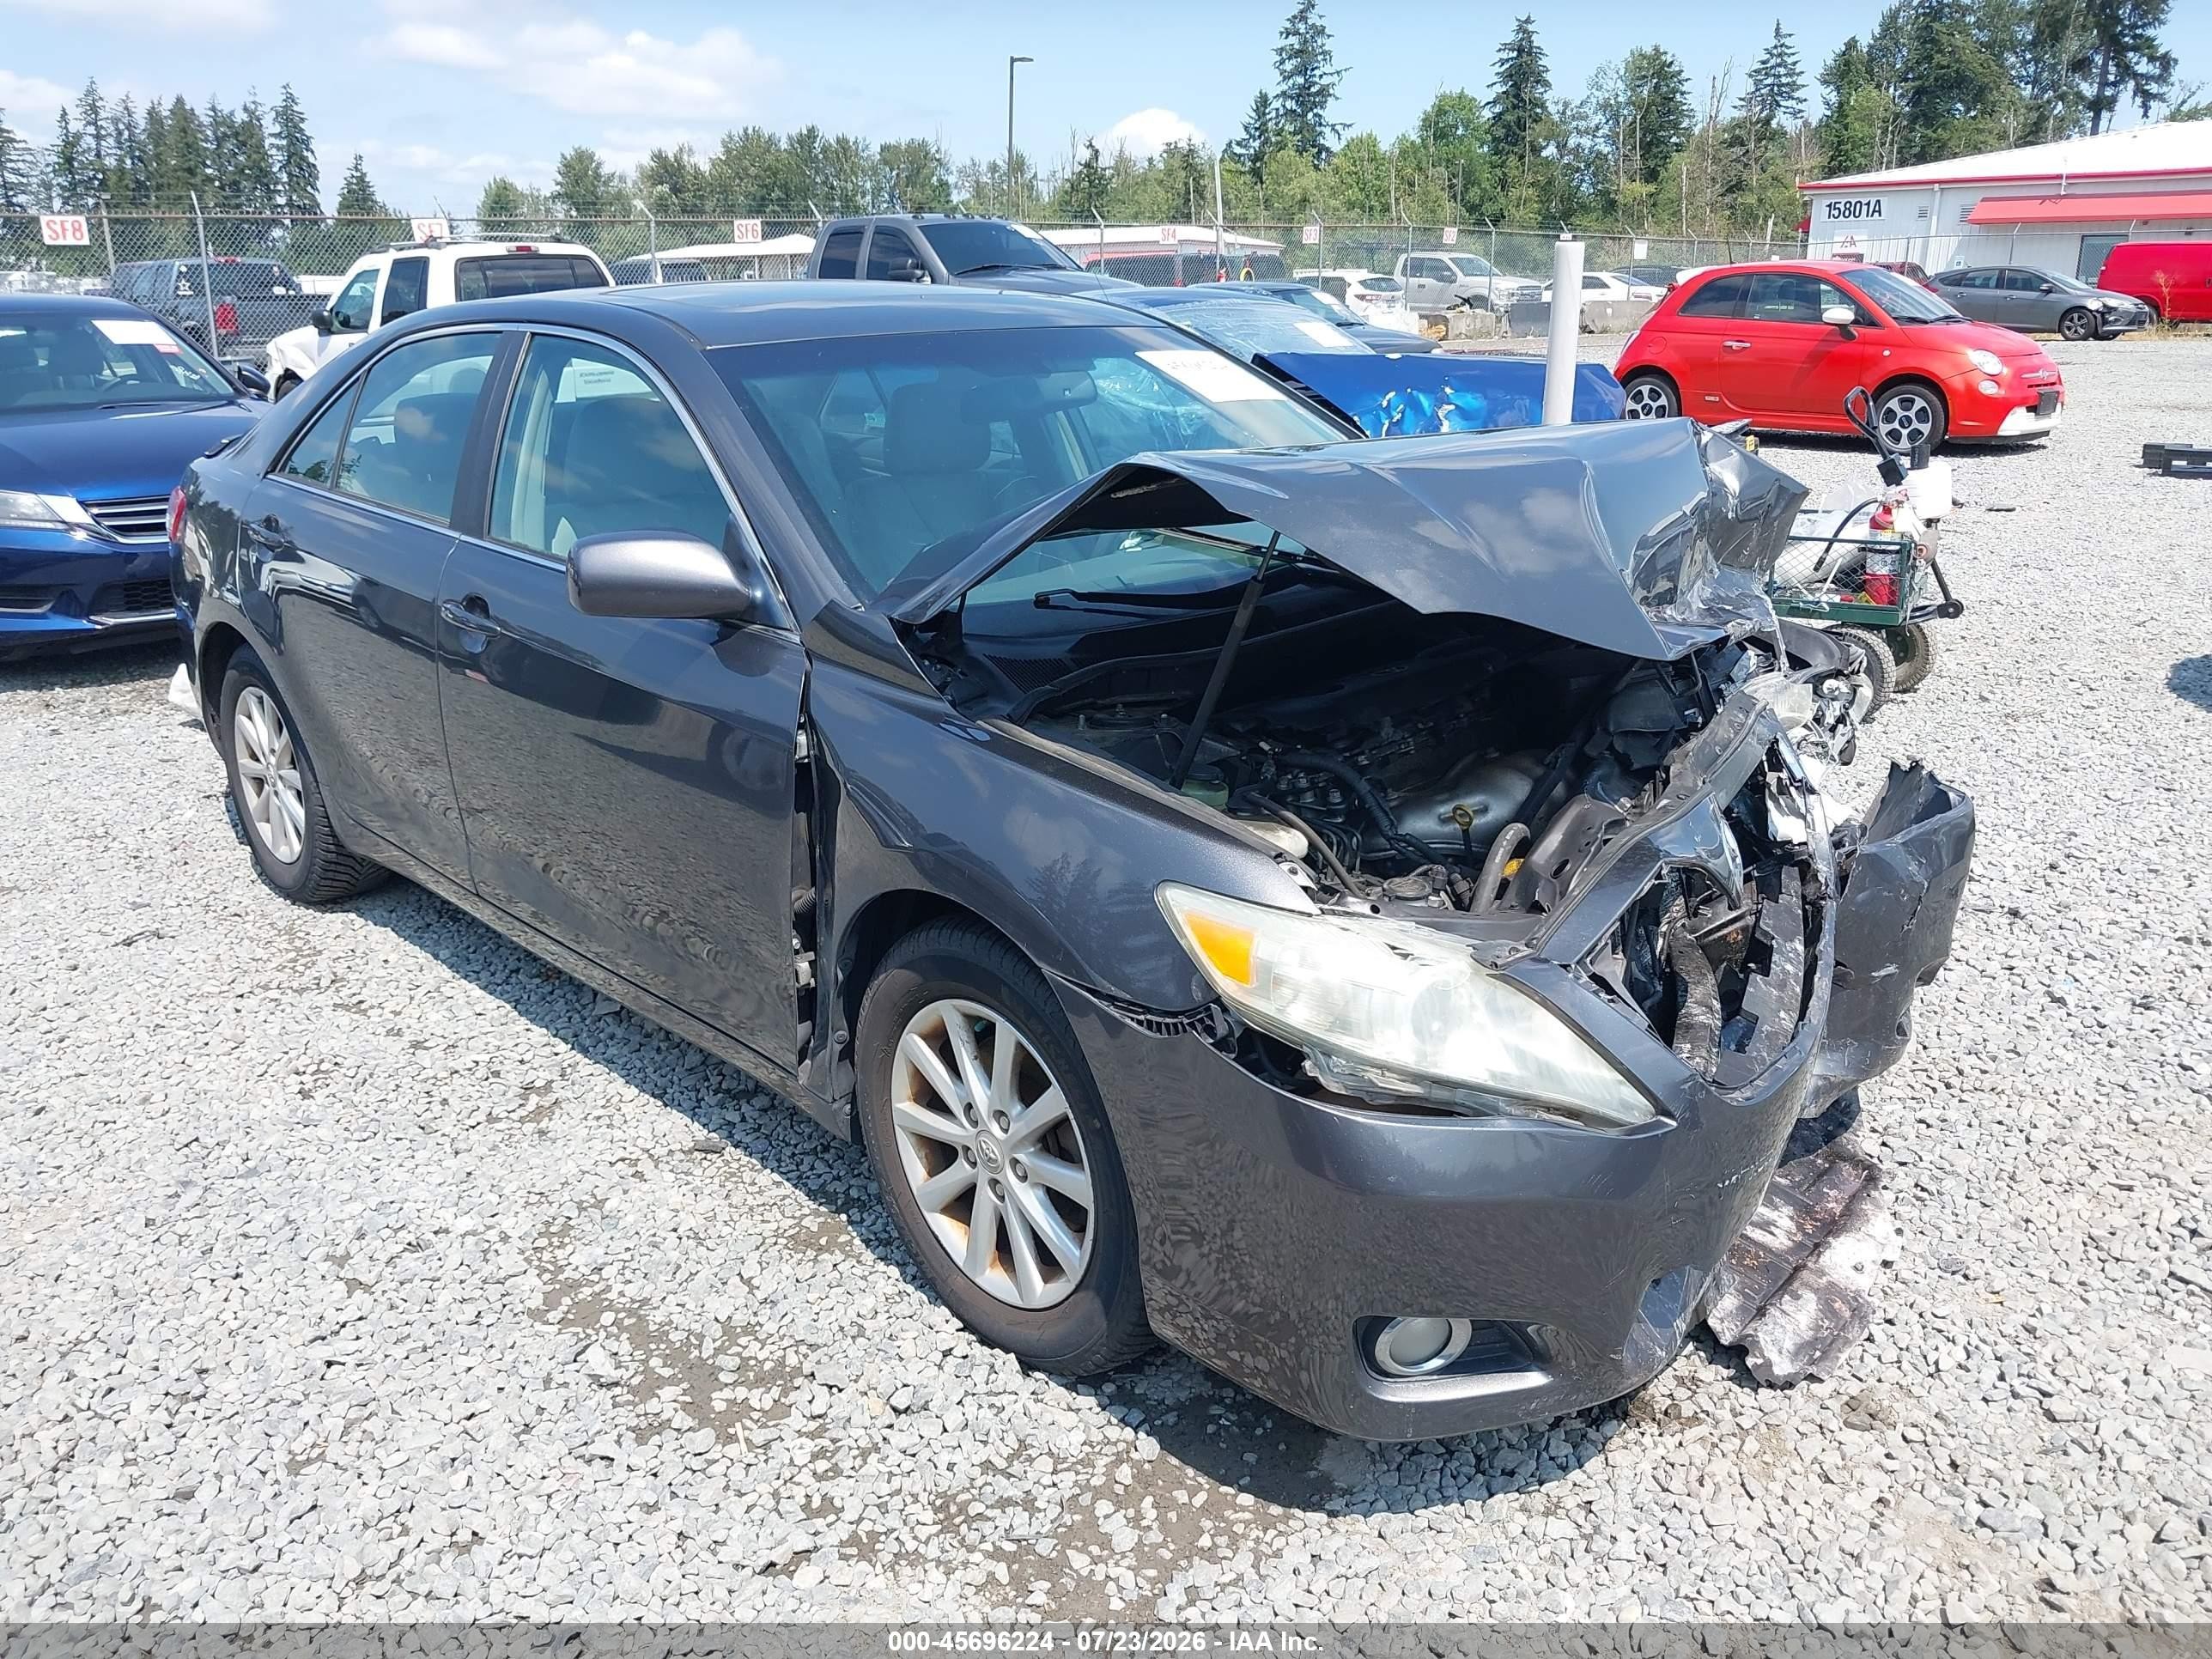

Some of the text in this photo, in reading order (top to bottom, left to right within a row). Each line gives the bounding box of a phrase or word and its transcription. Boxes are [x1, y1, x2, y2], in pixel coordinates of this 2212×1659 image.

[1826, 199, 1881, 219] 15801A
[46, 219, 84, 241] SF8
[737, 222, 759, 240] SF6
[1161, 228, 1176, 241] SF4
[1304, 228, 1318, 241] SF3
[1444, 229, 1456, 242] SF2
